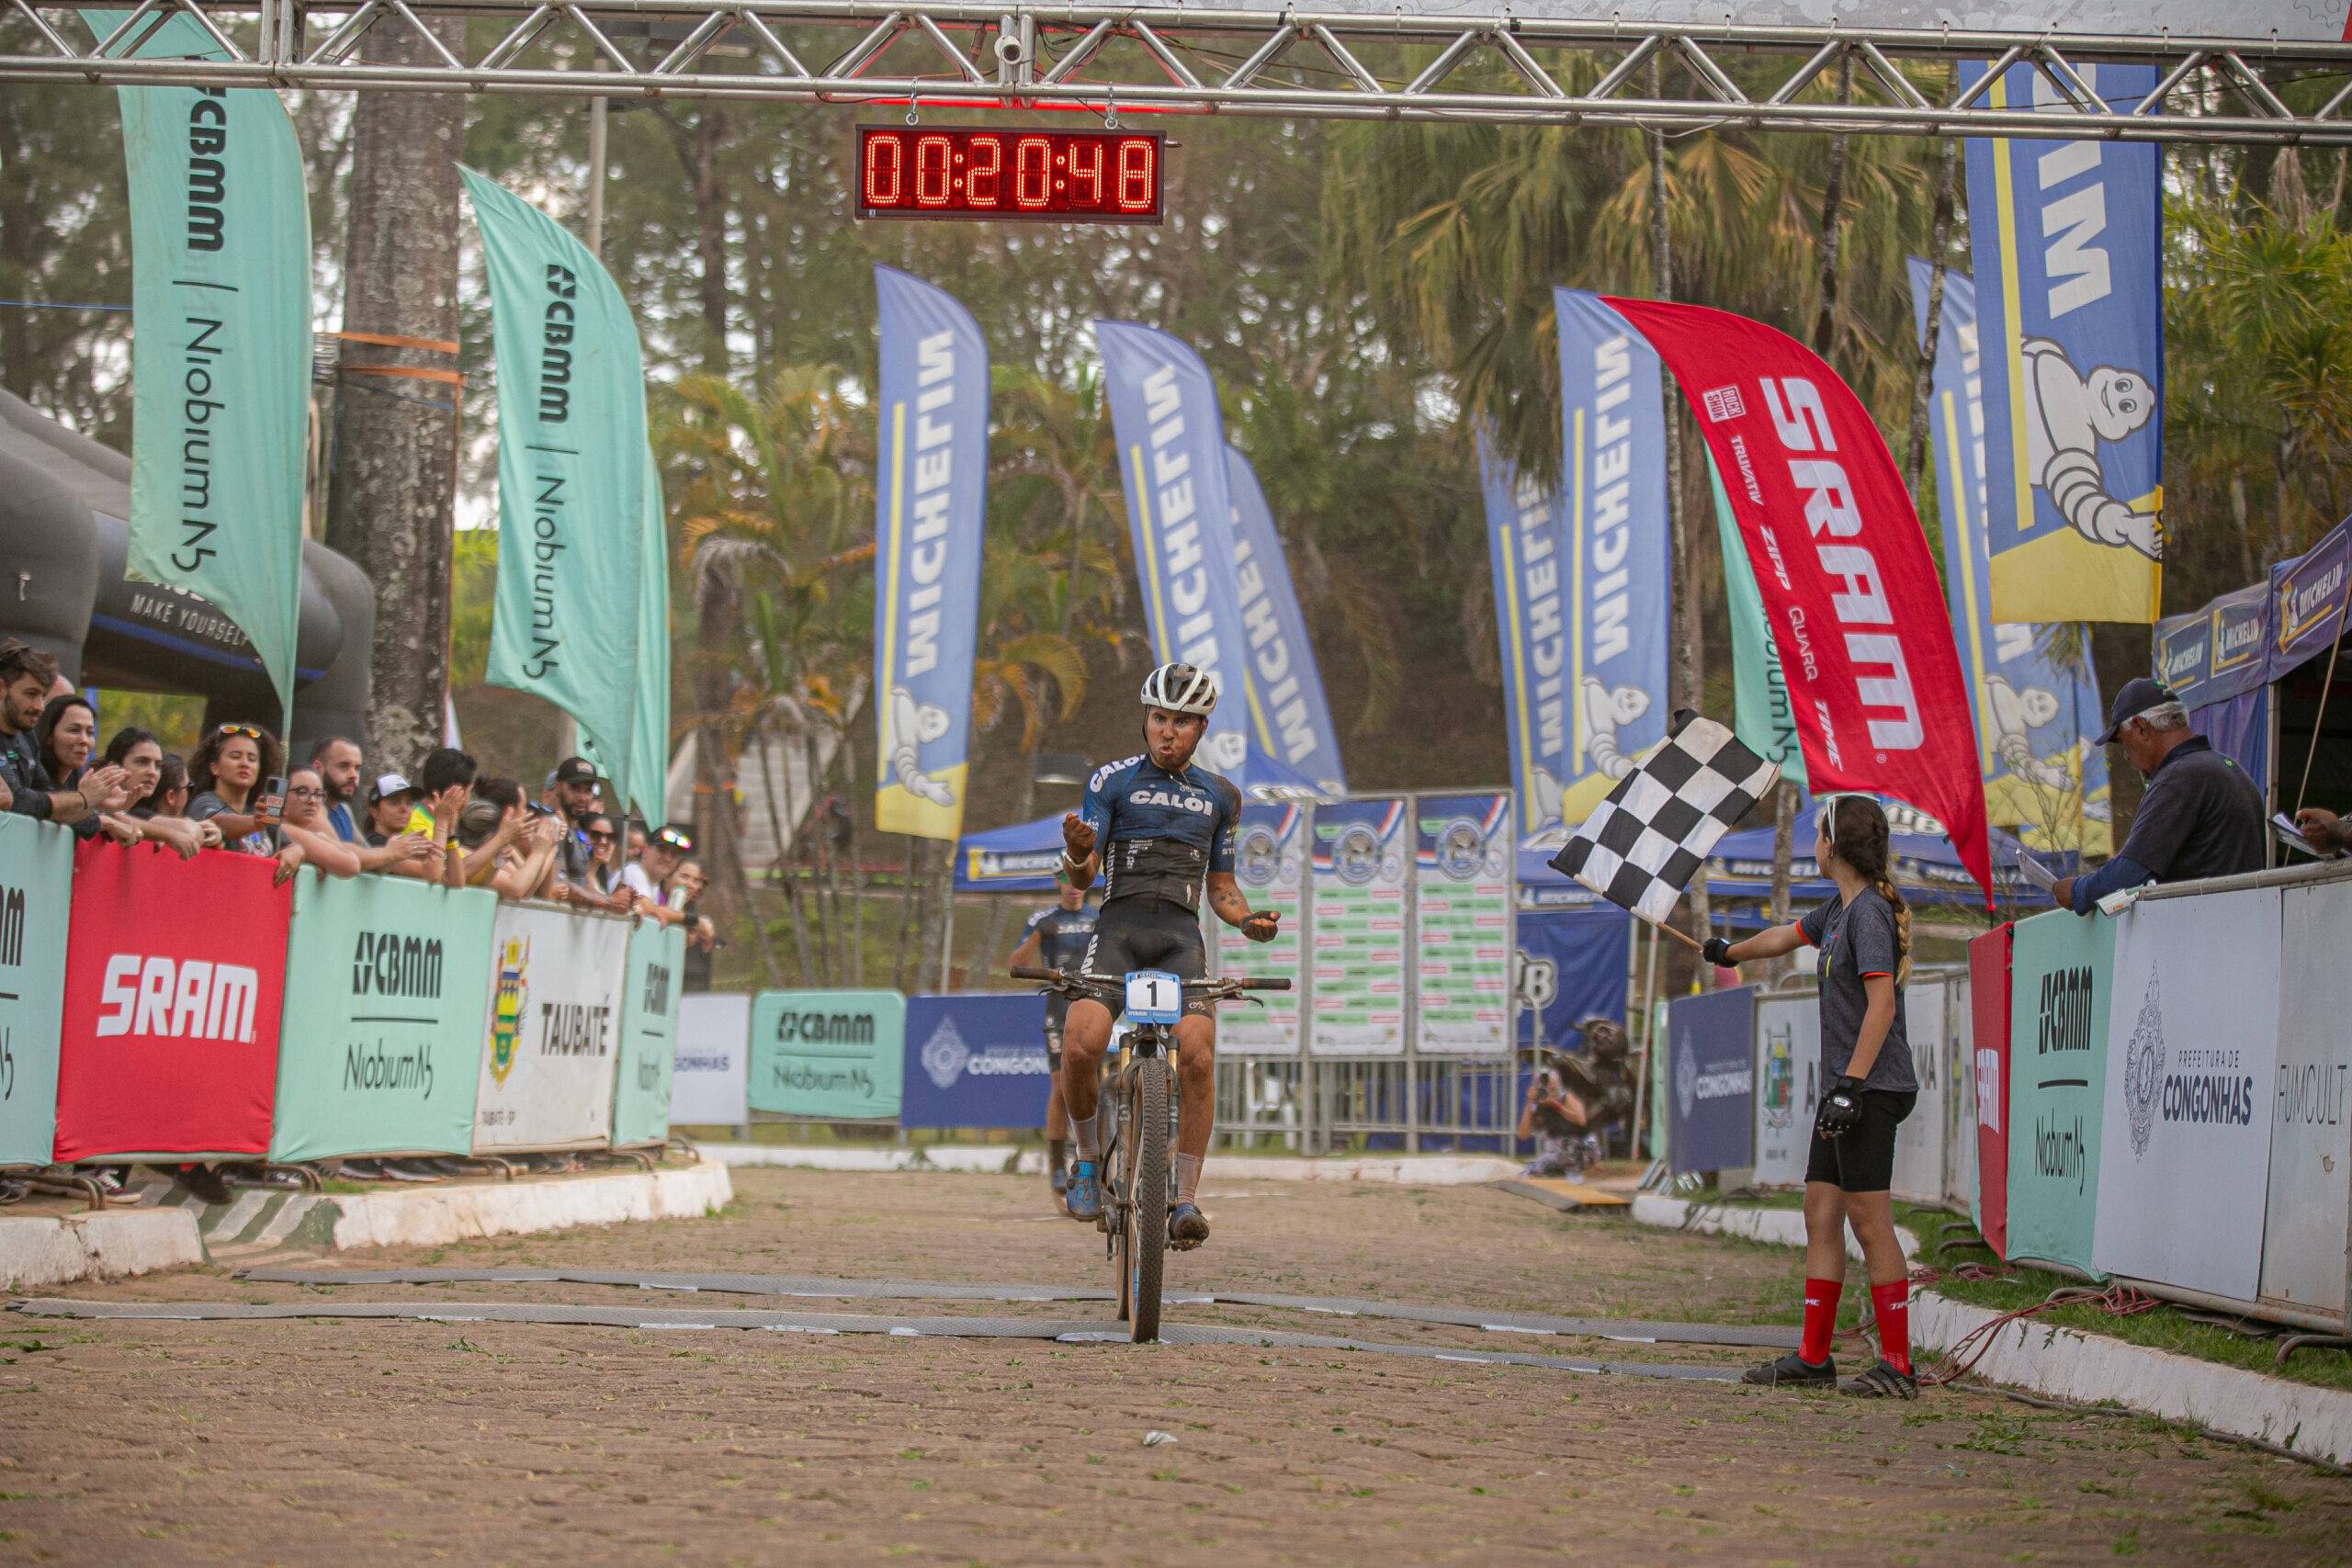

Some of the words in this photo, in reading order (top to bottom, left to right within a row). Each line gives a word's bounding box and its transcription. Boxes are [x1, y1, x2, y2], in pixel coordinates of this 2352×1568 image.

[866, 135, 1154, 209] 00:20:48
[1593, 332, 1632, 666] MICHELIN
[1730, 434, 1764, 505] TRUVATIV
[906, 330, 955, 678] MICHELIN
[1758, 377, 1925, 750] SRAM
[1759, 525, 1792, 591] ZIPP
[2300, 562, 2343, 617] MICHELIN
[130, 594, 175, 623] MAKE
[2225, 617, 2260, 651] MICHELIN
[2169, 641, 2204, 676] MICHELIN
[1814, 699, 1843, 772] TIME
[1129, 790, 1213, 816] CALOI
[96, 953, 258, 1043] SRAM
[541, 993, 610, 1056] TAUBATÉ
[1147, 981, 1158, 1008] 1
[2177, 1050, 2226, 1068] PREFEITURA
[2227, 1050, 2240, 1068] DE
[2163, 1074, 2253, 1126] CONGONHAS
